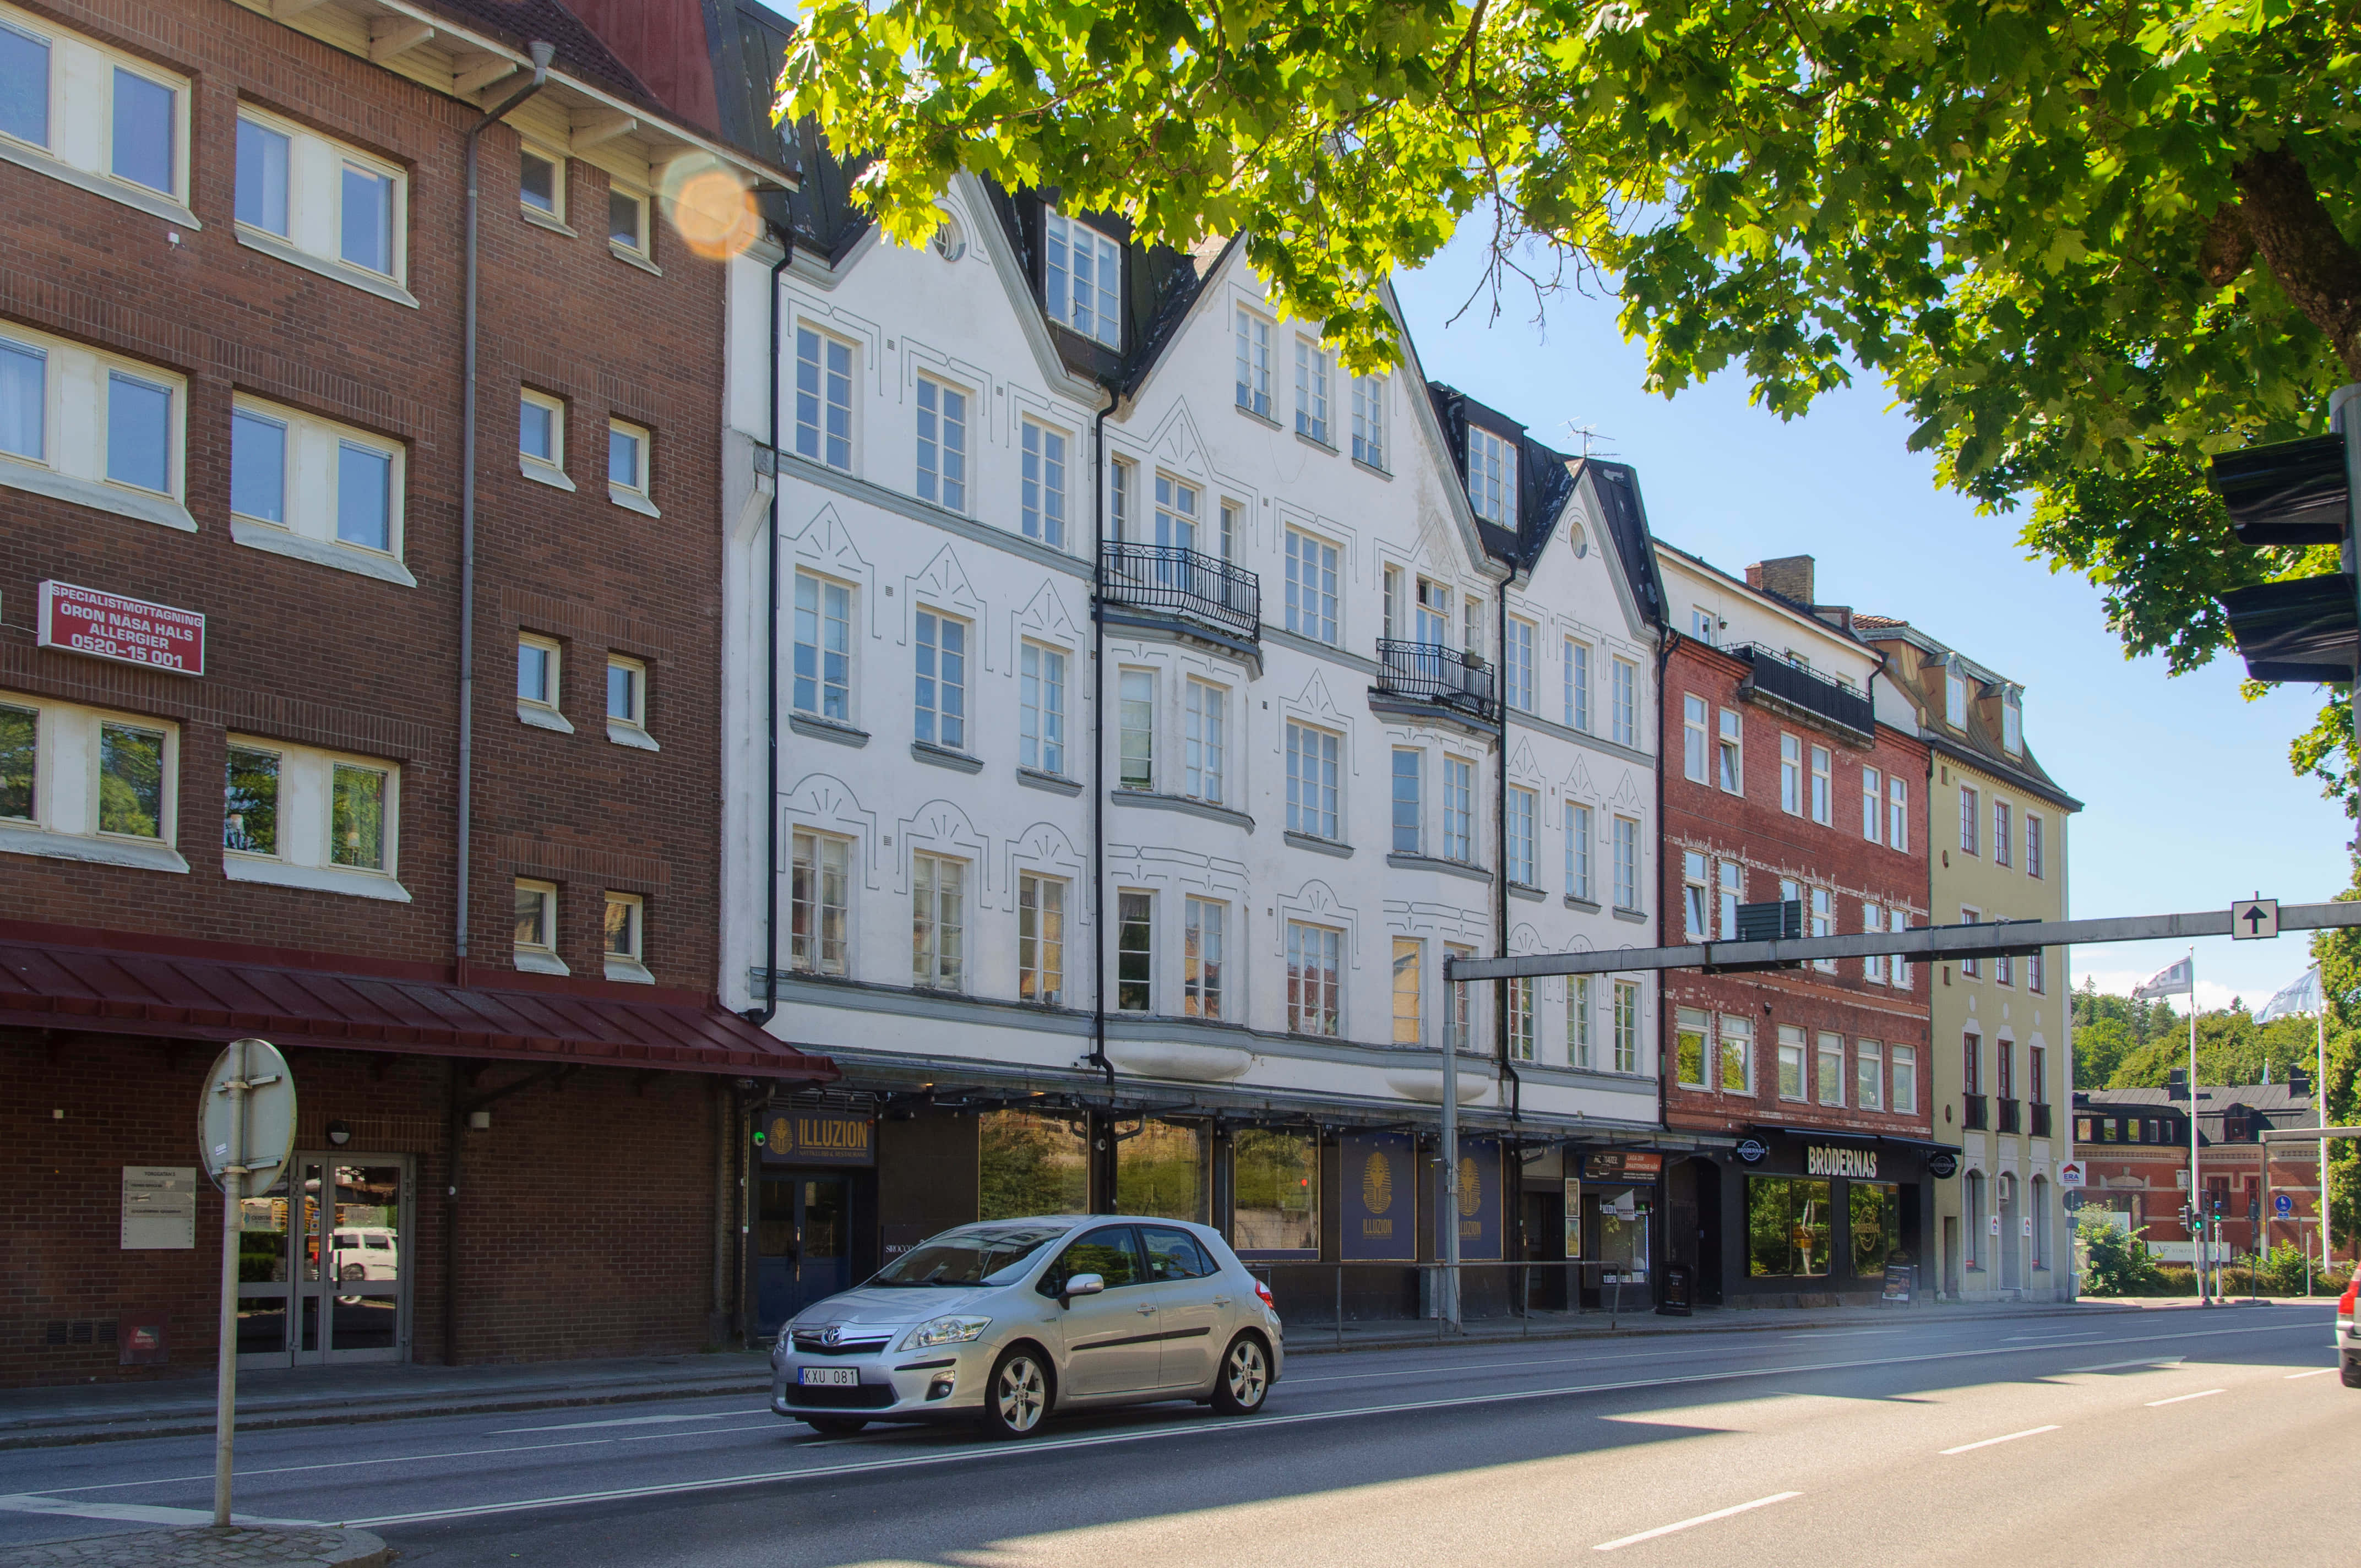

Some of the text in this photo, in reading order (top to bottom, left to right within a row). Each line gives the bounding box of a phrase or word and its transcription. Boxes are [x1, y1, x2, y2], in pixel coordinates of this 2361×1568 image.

[52, 585, 202, 628] SPECIALISTMOTTAGNING
[61, 600, 194, 642] ÖRON NÄSA HALS
[72, 633, 183, 668] 0520-15 001
[89, 622, 170, 650] ALLERGIER
[799, 1118, 868, 1148] ILLUZION
[1808, 1143, 1877, 1178] BRÖDERNAS
[1363, 1218, 1392, 1234] ILLUZION
[805, 1370, 854, 1384] KXU 081
